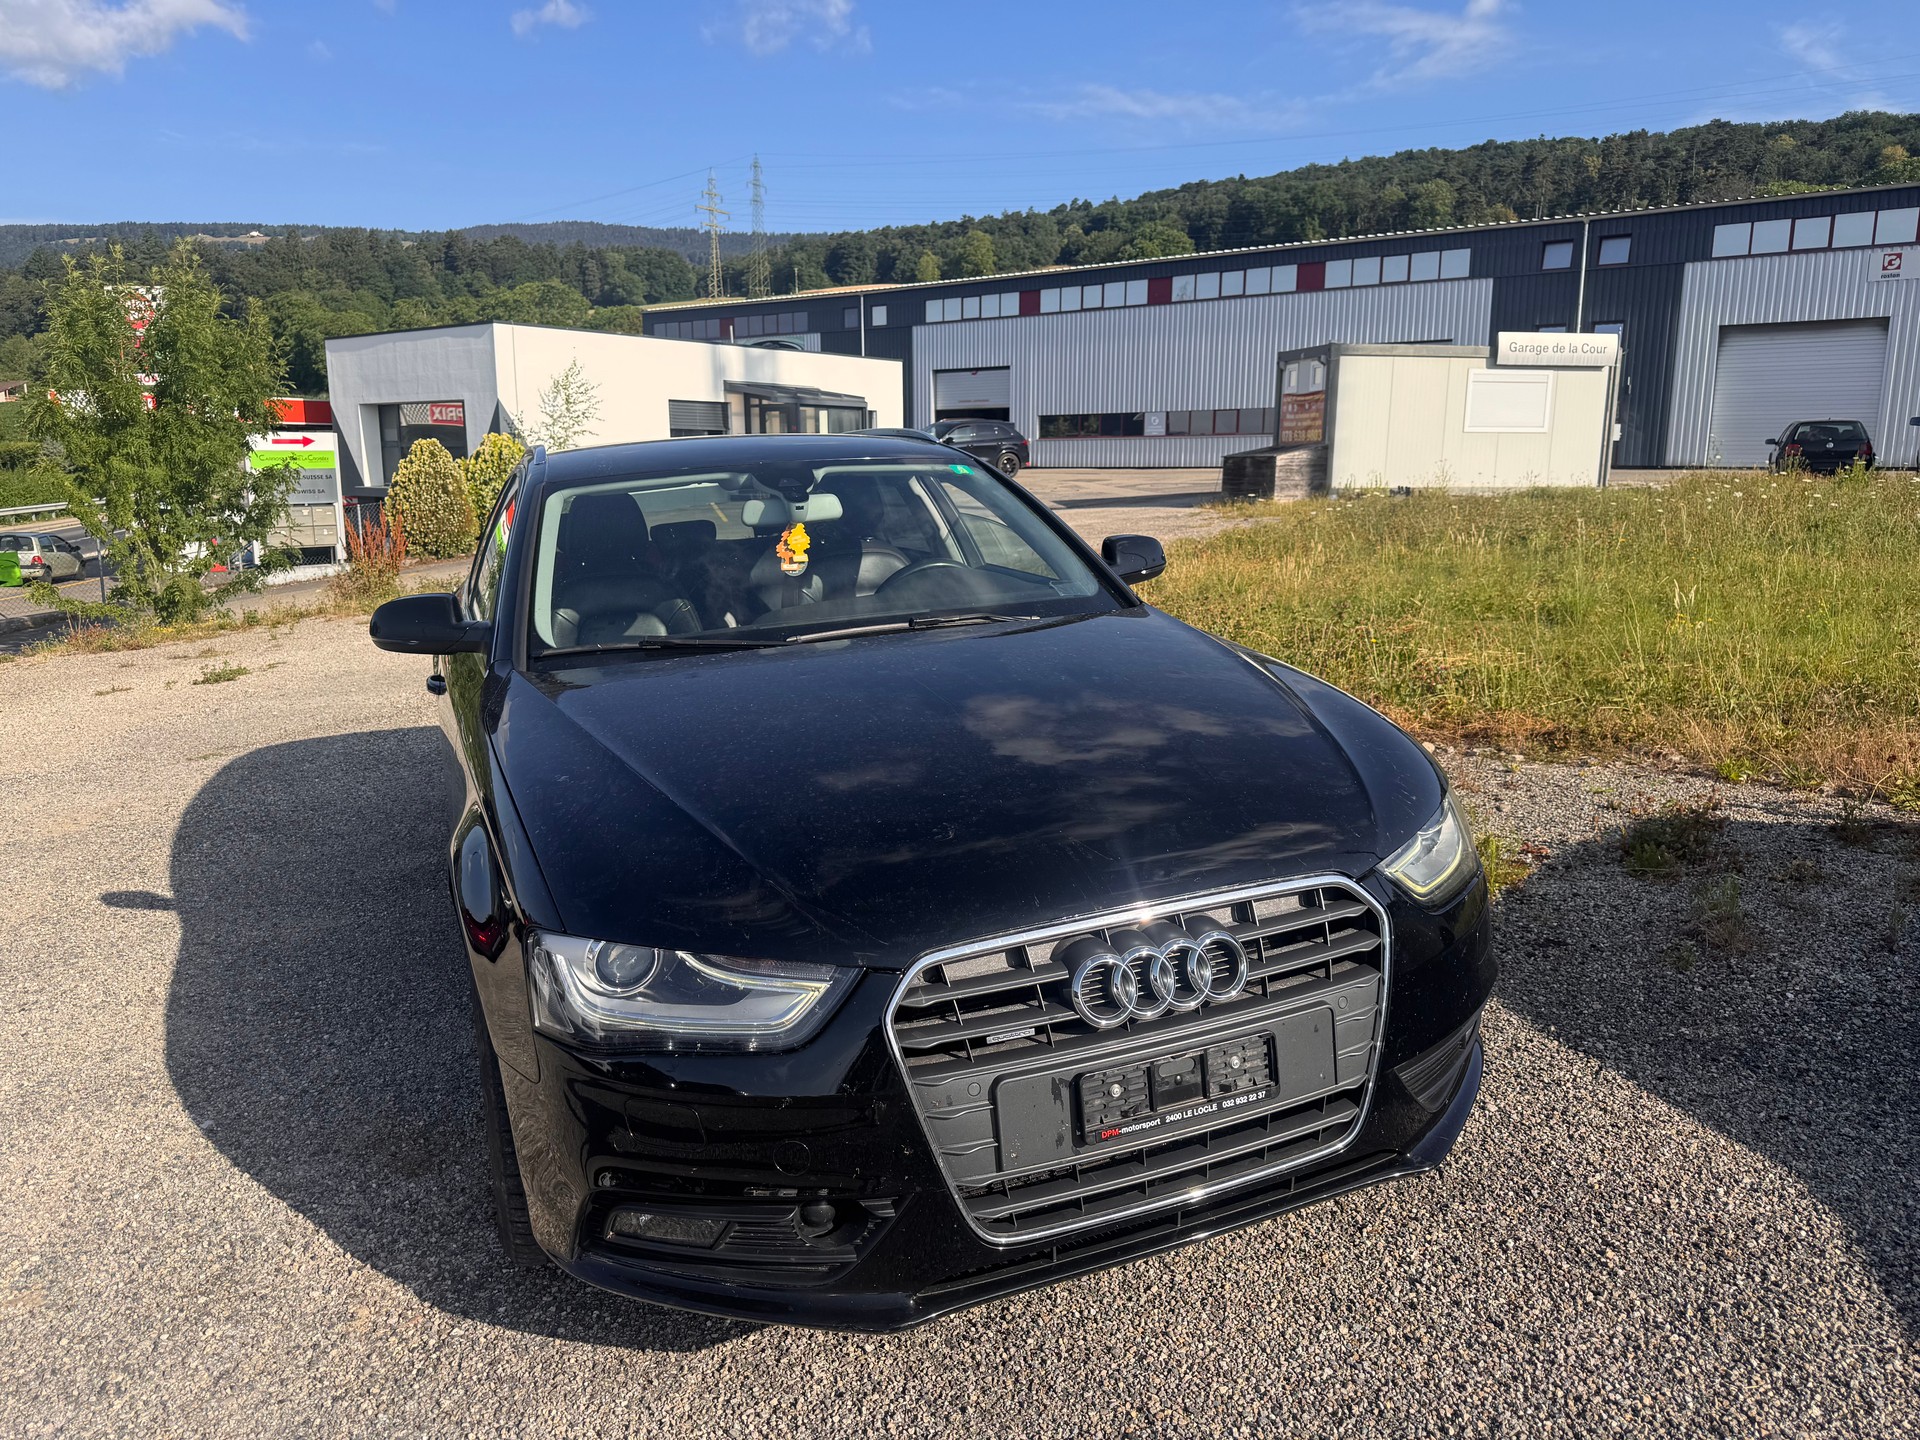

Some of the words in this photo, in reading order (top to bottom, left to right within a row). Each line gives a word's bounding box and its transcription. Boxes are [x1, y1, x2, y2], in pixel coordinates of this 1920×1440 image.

[1509, 342, 1549, 355] Garage
[1552, 342, 1566, 354] de
[1568, 342, 1578, 354] la
[1581, 343, 1608, 355] Cour
[1101, 1118, 1161, 1139] DPM-motorsport
[1165, 1112, 1183, 1123] 2400
[1183, 1109, 1193, 1118] LE
[1193, 1103, 1218, 1116] LOCLE
[1222, 1099, 1235, 1109] 032
[1235, 1096, 1249, 1106] 932
[1248, 1094, 1258, 1103] 22
[1257, 1091, 1267, 1100] 37
